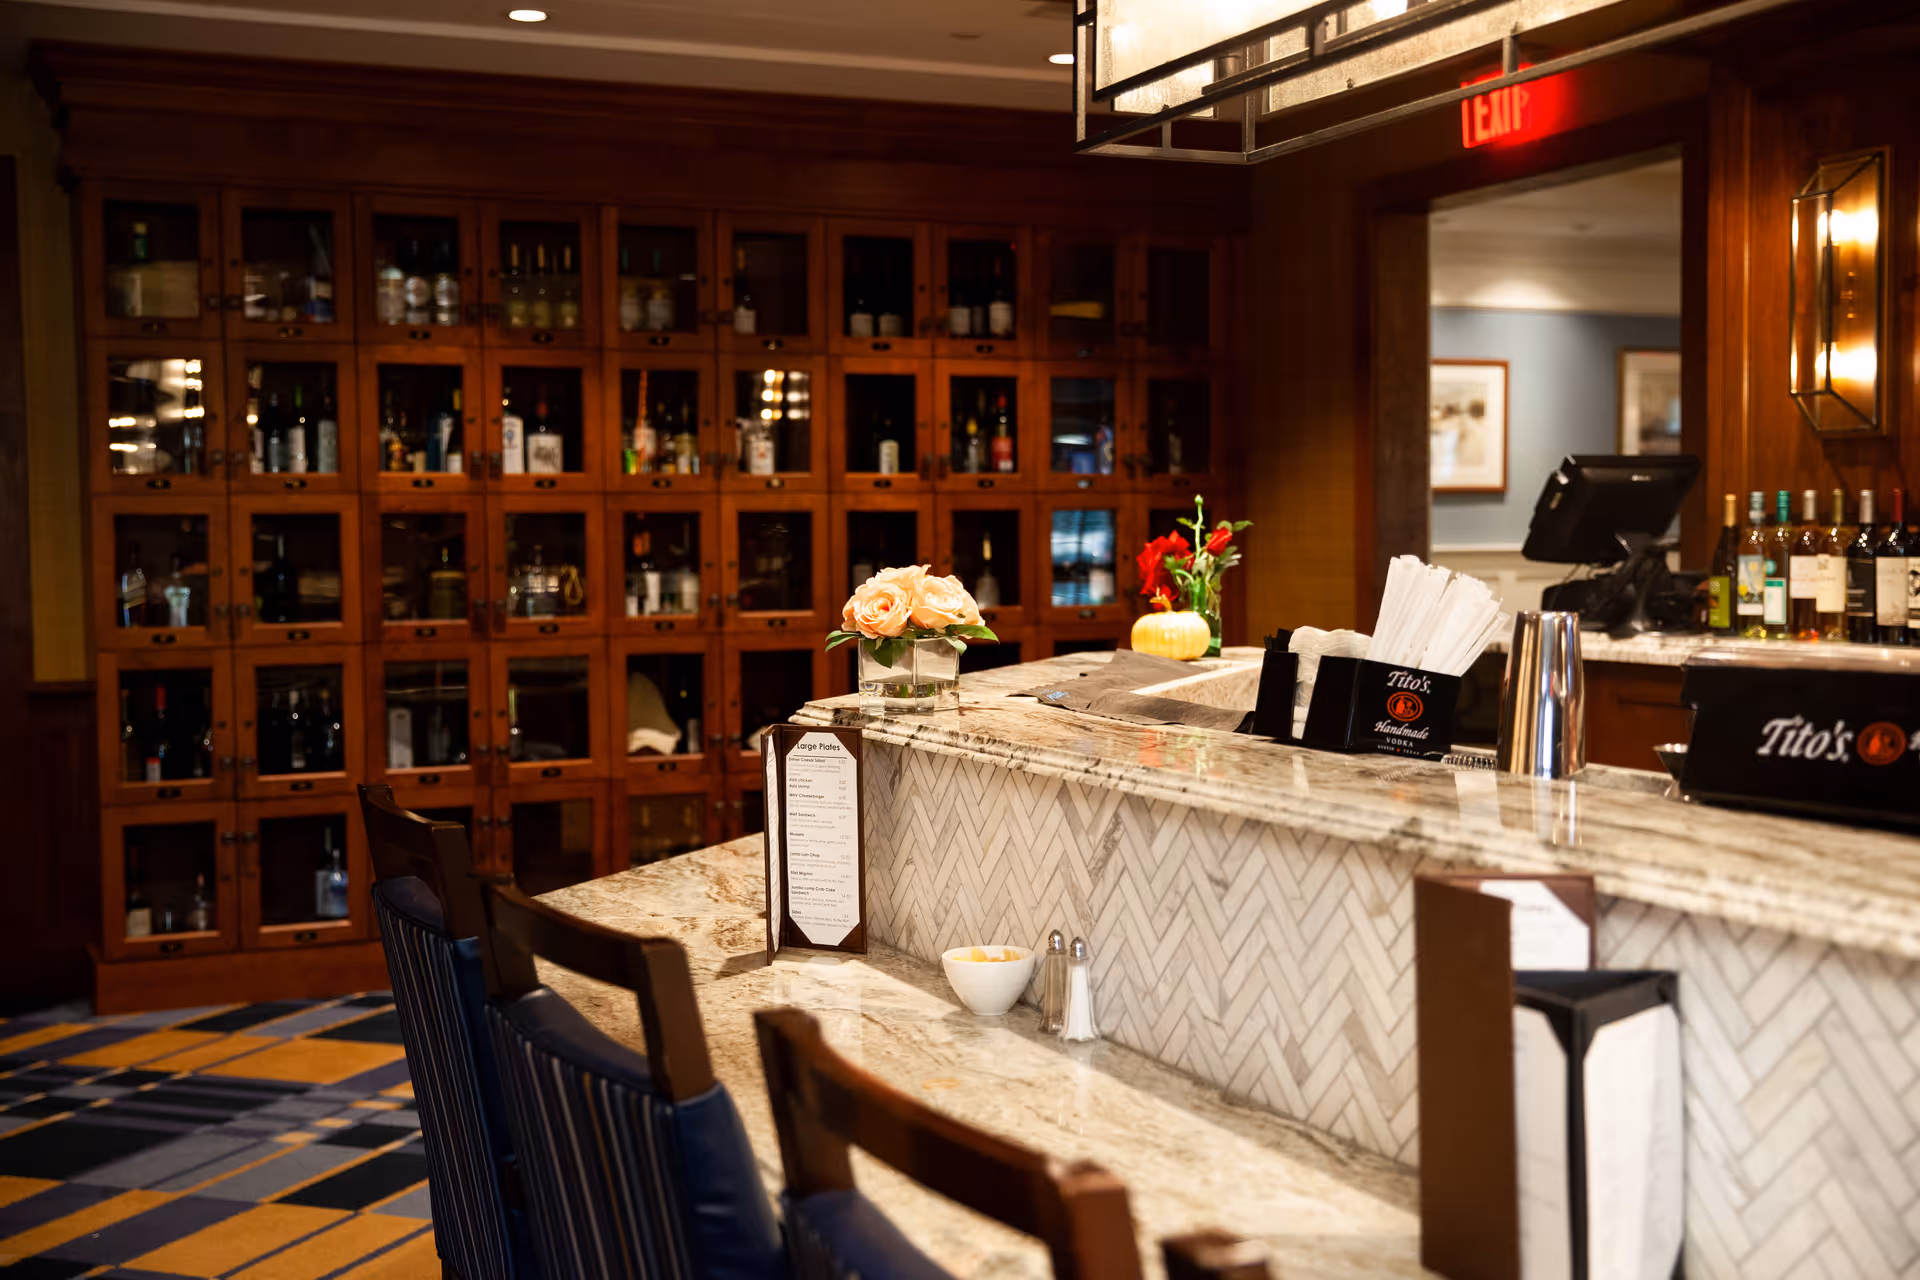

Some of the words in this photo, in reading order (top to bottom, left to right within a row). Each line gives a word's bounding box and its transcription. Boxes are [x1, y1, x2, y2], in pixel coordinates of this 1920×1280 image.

[1387, 670, 1431, 693] Tito's
[1374, 720, 1430, 740] Handmade
[1756, 713, 1853, 763] Tito's
[798, 743, 817, 752] Large
[1386, 737, 1414, 748] VODKA
